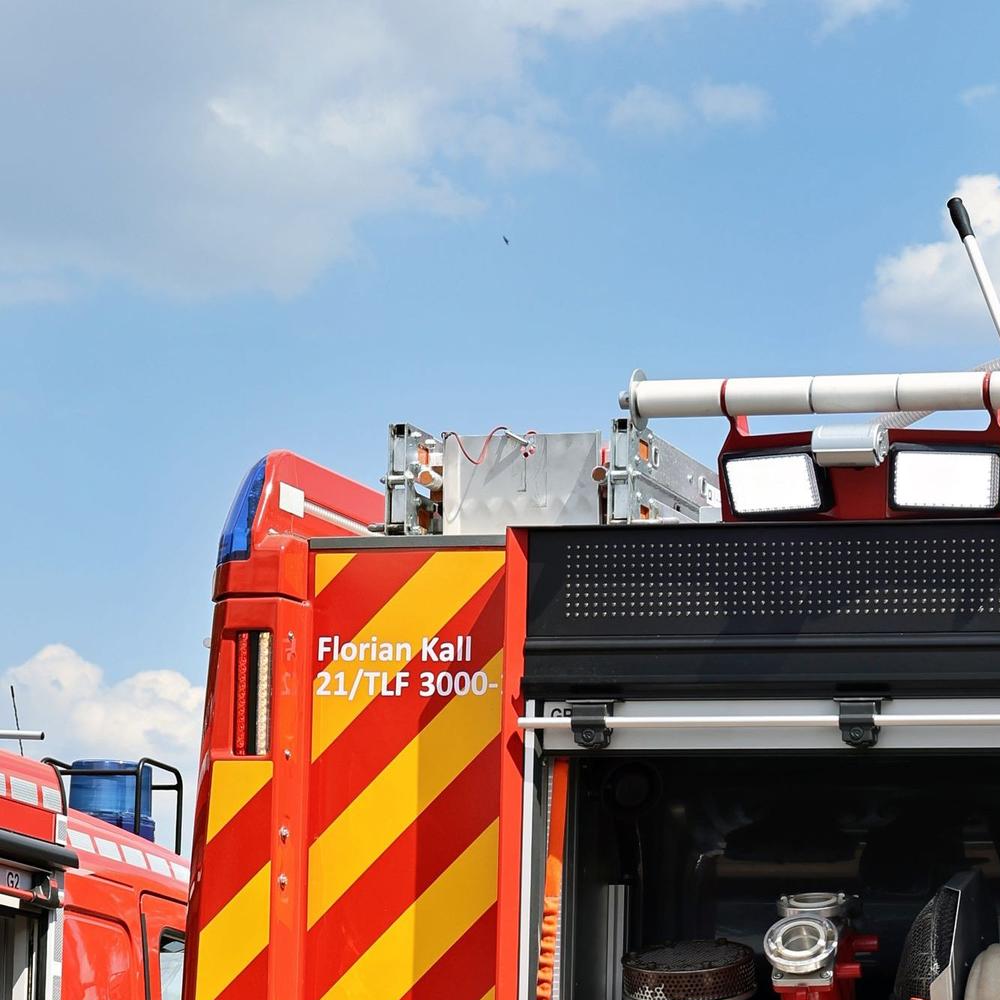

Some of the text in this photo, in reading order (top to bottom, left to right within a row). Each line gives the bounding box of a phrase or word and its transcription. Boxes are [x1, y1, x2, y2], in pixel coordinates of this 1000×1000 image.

[317, 635, 472, 662] Florian Kall
[315, 668, 504, 701] 21/TLF 3000-
[7, 871, 20, 890] G2
